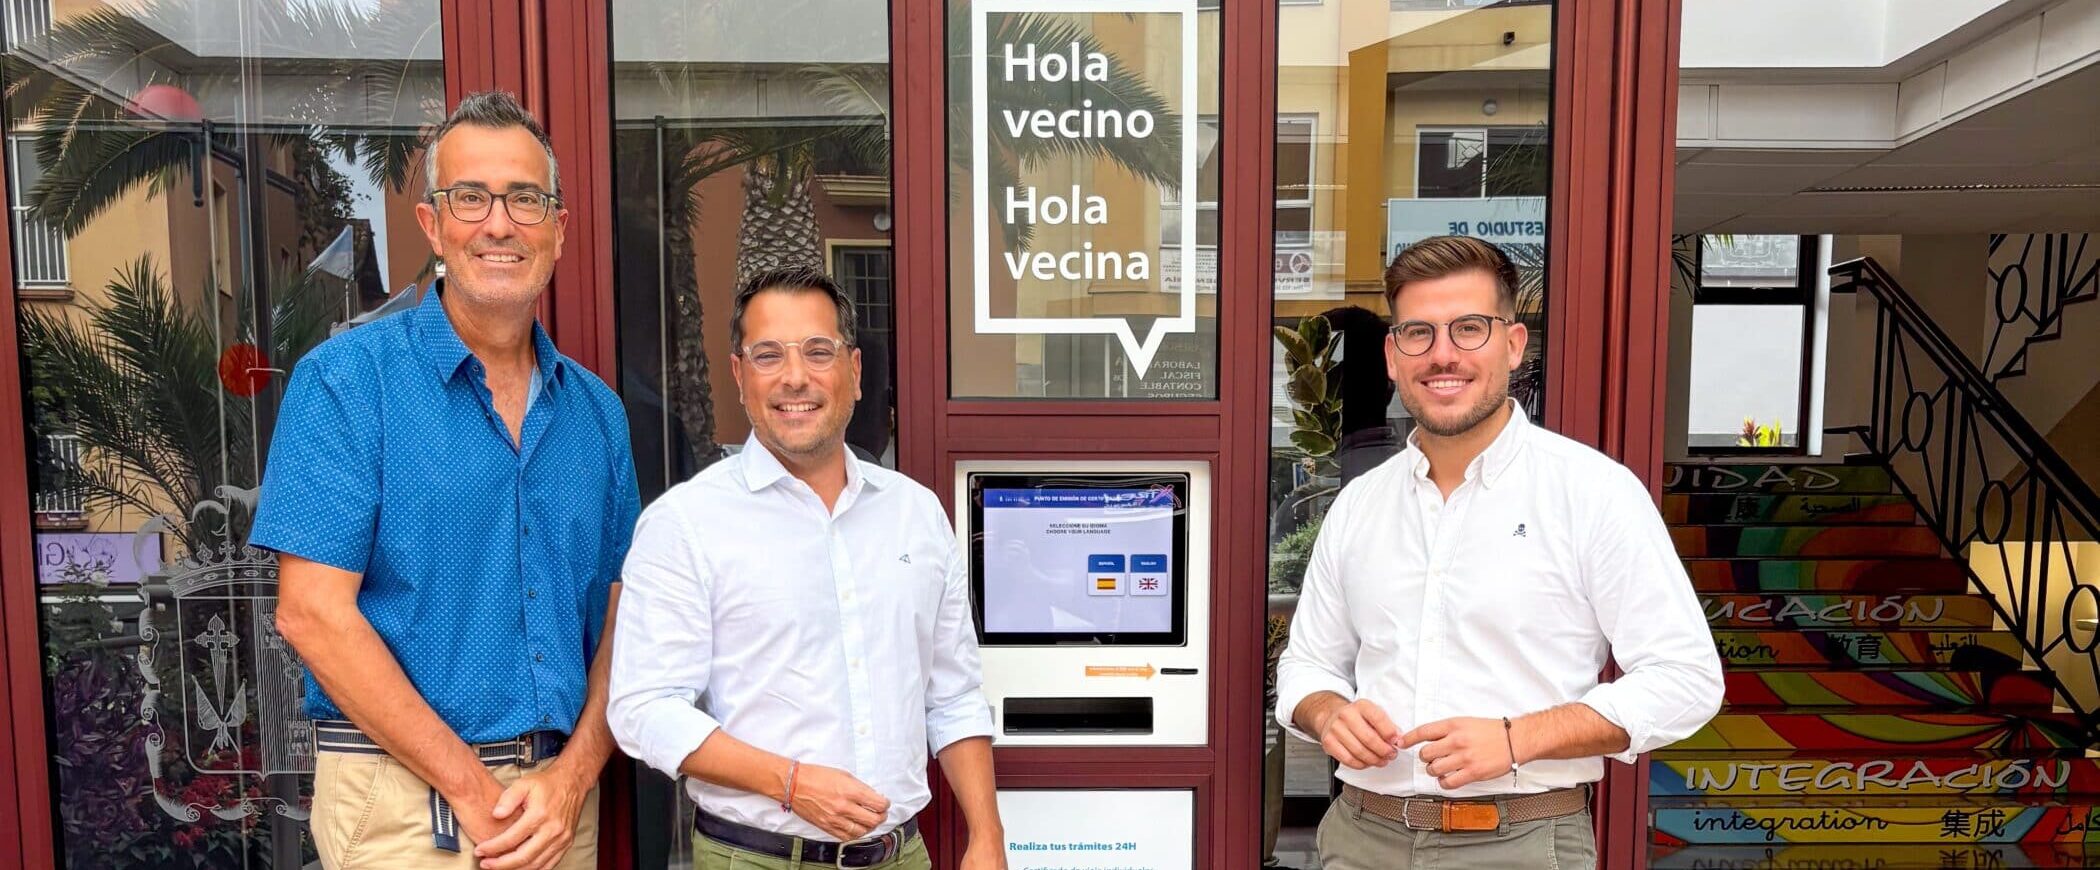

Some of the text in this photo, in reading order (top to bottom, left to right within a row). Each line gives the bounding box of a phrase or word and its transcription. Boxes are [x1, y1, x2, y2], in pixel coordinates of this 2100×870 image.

[1004, 42, 1109, 82] Hola
[1003, 99, 1155, 139] vecino
[1005, 185, 1108, 225] Hola
[1004, 241, 1150, 280] vecina
[1685, 759, 2071, 791] INTEGRACIÓN
[1693, 810, 1889, 841] integration
[1940, 809, 2007, 839] 集成
[1009, 842, 1137, 851] Realiza tus trámites 24H
